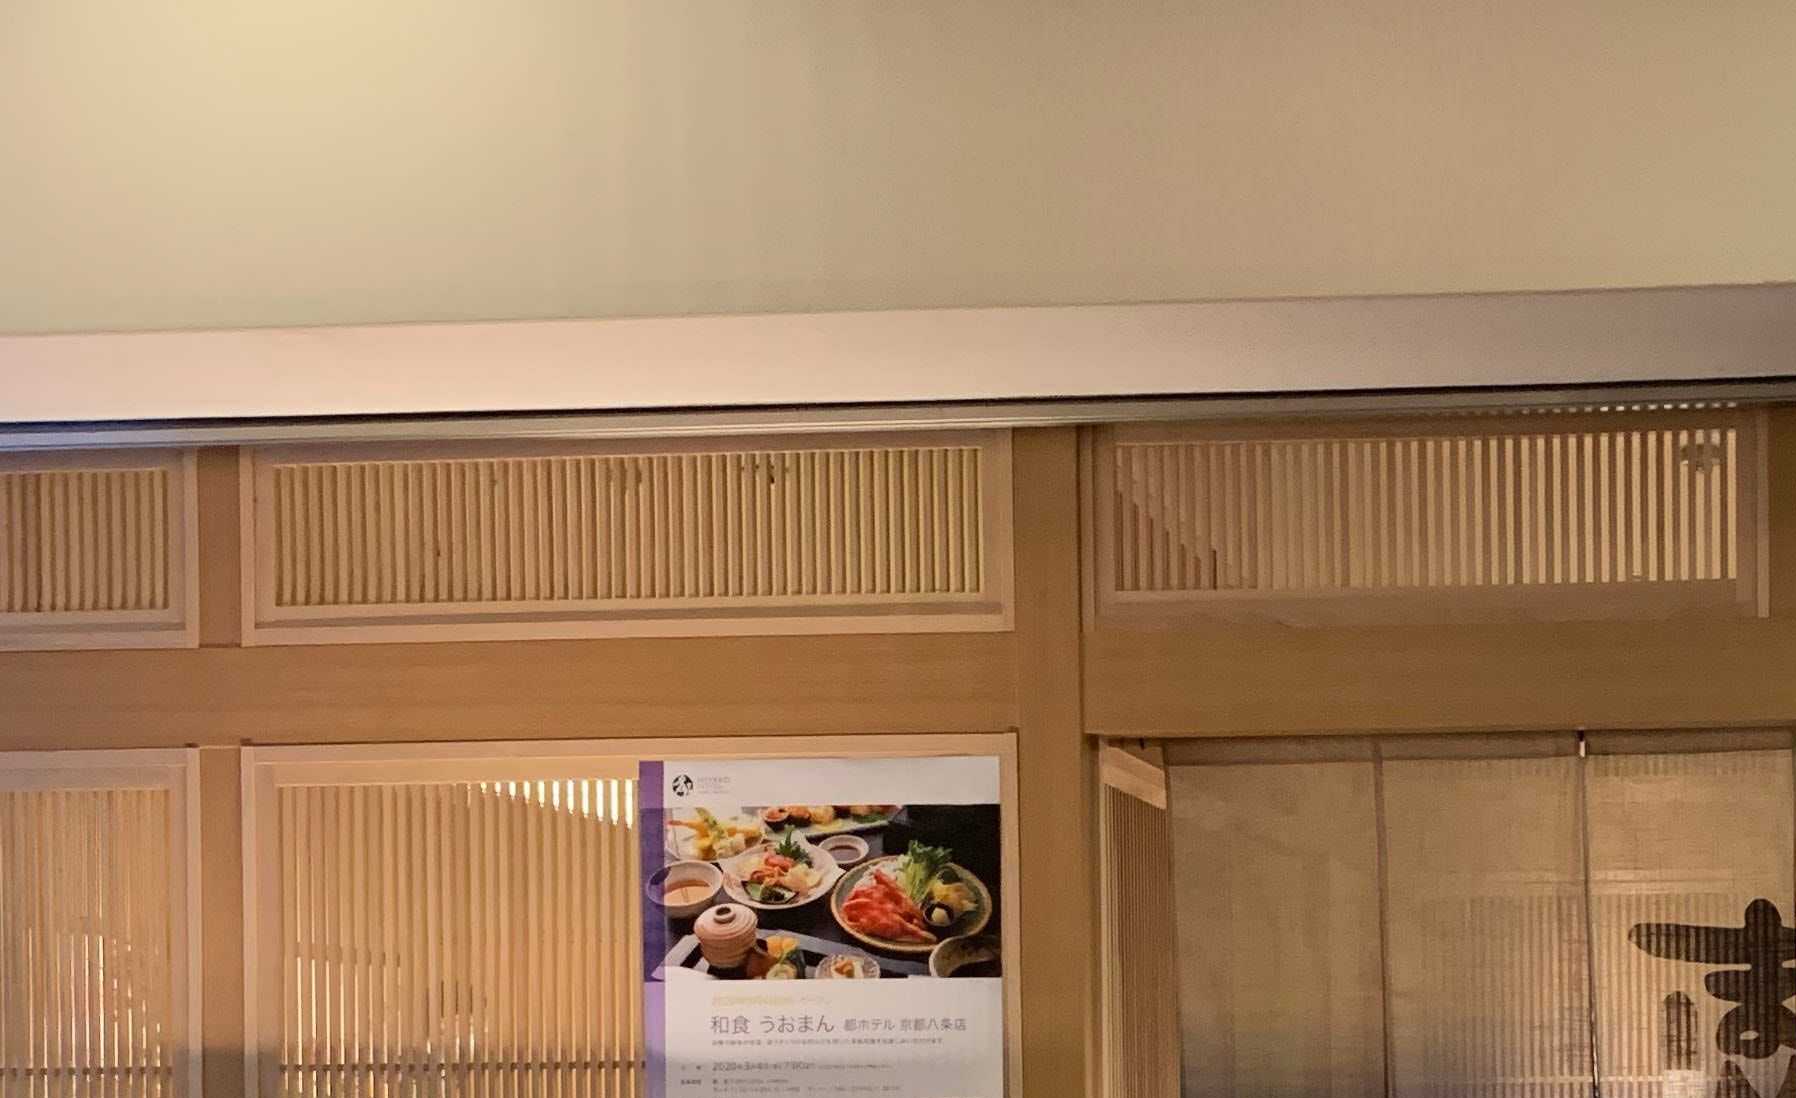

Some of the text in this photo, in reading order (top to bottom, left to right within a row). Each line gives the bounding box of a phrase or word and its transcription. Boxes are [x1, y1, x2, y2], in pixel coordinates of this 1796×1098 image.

[710, 1014, 967, 1034] 和食 うおまん 都ホテル 京都八条店
